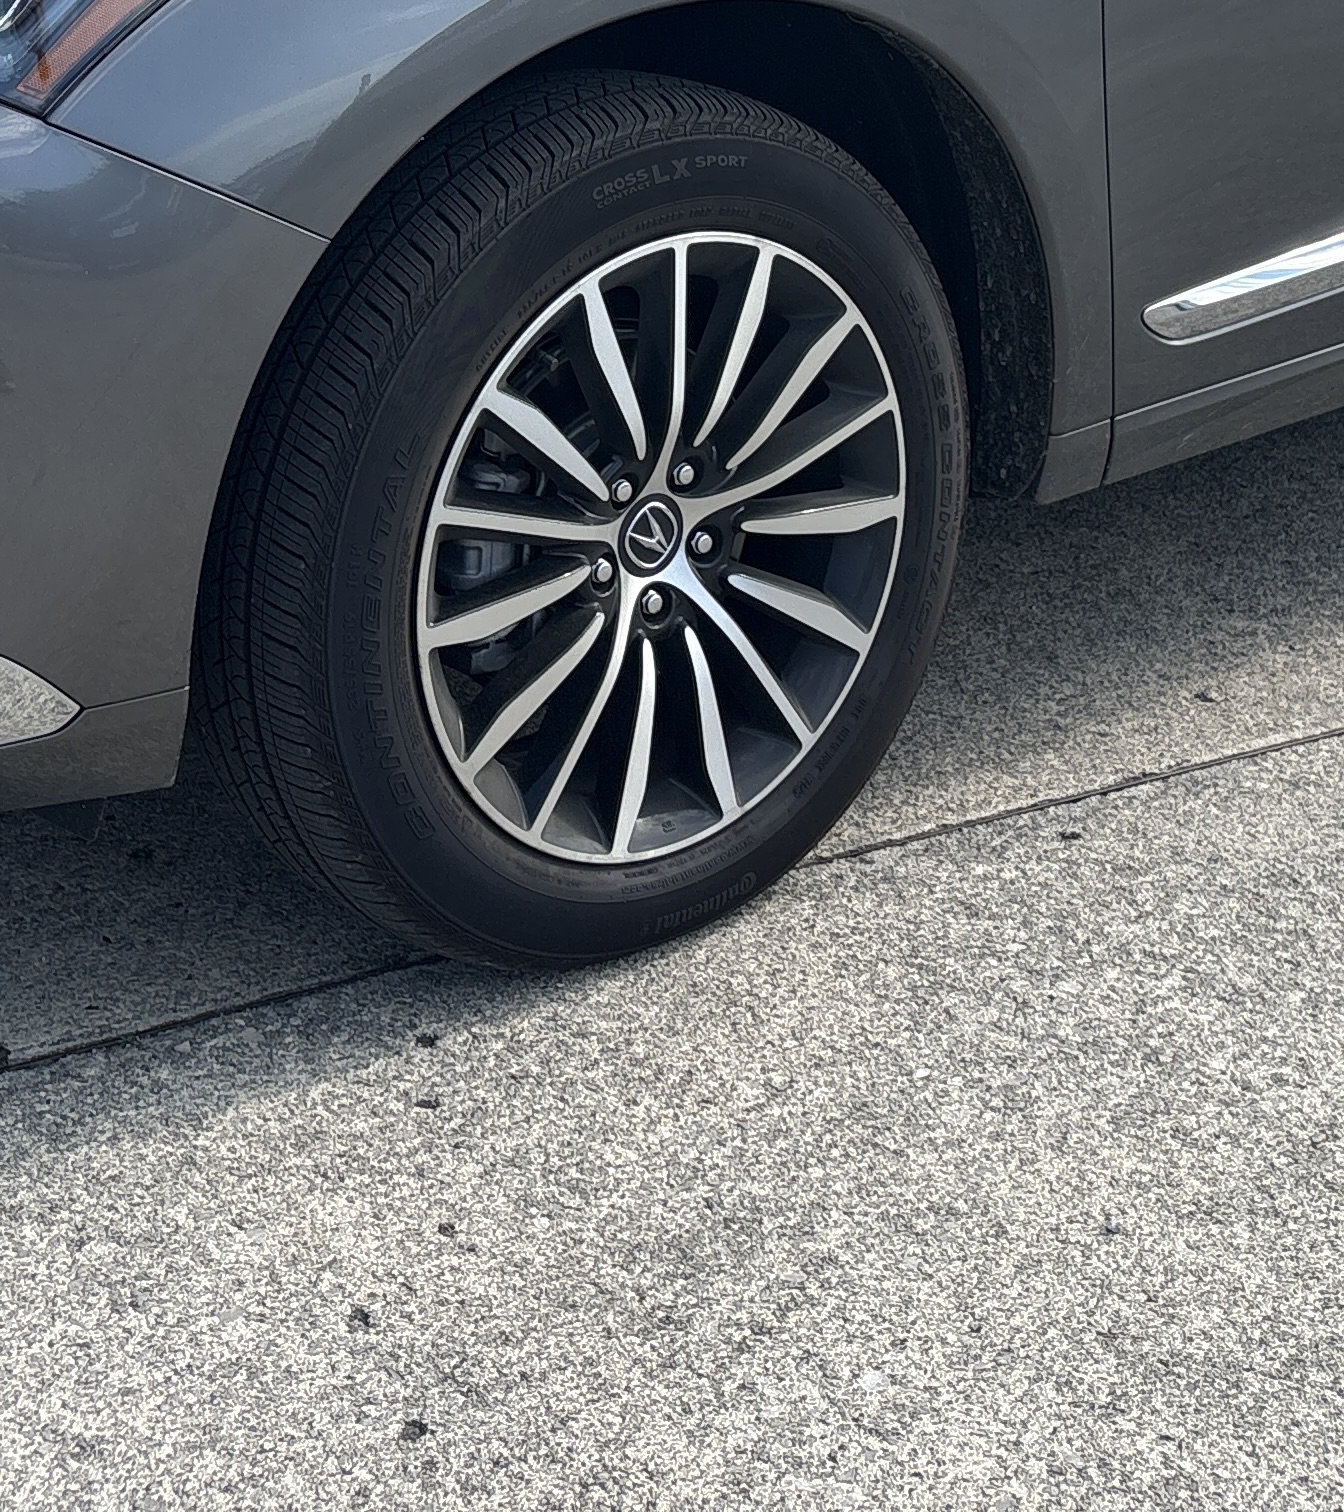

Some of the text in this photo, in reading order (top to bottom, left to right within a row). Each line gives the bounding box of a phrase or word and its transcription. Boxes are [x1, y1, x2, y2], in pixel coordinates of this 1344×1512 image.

[592, 155, 749, 201] CROSS LX SPORT
[596, 181, 652, 209] CONTACT
[361, 431, 436, 841] CONTINENTAL
[656, 871, 756, 934] Continental
